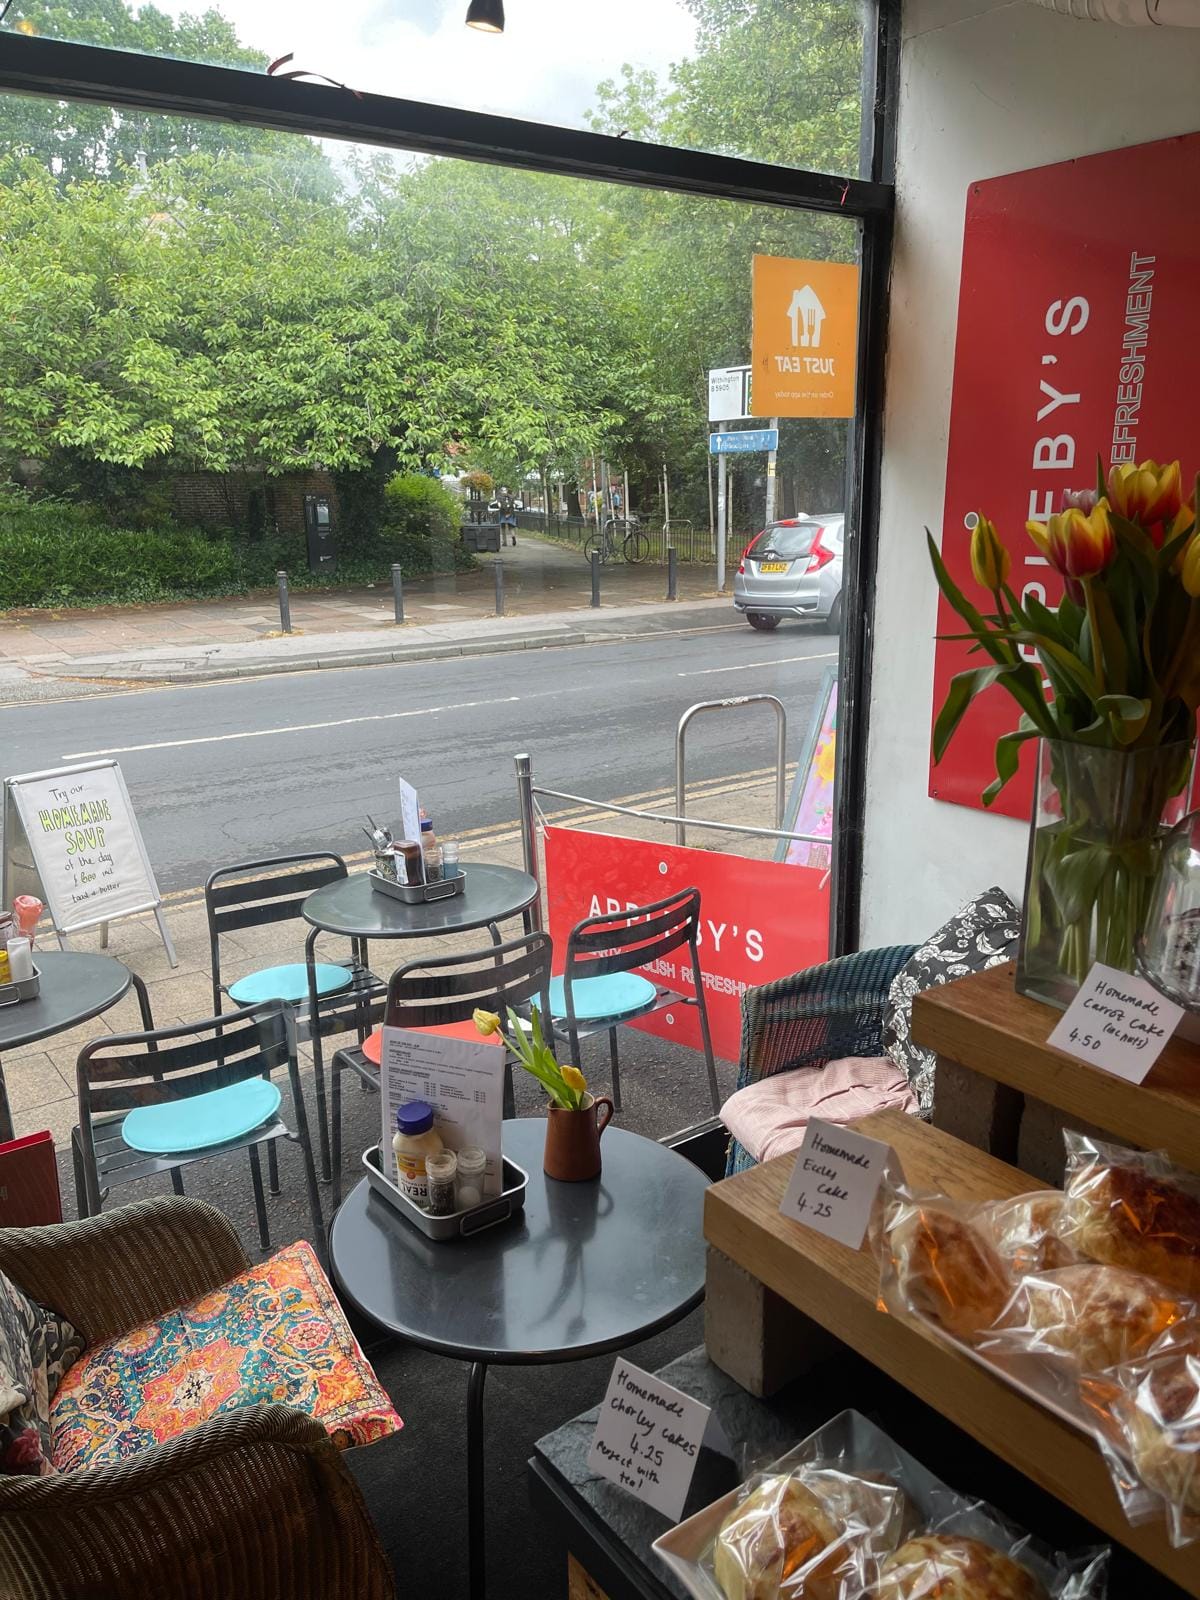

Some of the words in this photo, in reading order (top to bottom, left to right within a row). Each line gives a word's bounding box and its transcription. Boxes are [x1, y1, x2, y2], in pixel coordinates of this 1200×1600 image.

[1109, 251, 1156, 472] EFRESHMENT
[711, 375, 740, 384] Withington
[1020, 296, 1089, 690] PEBY'S
[48, 788, 69, 804] Try
[70, 784, 84, 795] our
[39, 799, 111, 832] HOMEMADE
[65, 827, 105, 855] SOUP
[65, 858, 74, 871] of
[78, 856, 95, 867] the
[98, 851, 114, 866] day
[589, 895, 764, 962] APPY'S
[638, 958, 676, 979] GLISH
[1095, 981, 1160, 1016] Homemade
[1083, 998, 1125, 1021] Carrot
[1129, 1018, 1165, 1038] Cake
[1069, 1028, 1101, 1050] 4.50
[1119, 1033, 1149, 1050] nuts)
[811, 1133, 870, 1169] Homemade
[797, 1192, 832, 1218] 4.25
[617, 1370, 685, 1418] Homemade
[610, 1397, 656, 1437] Chorley
[630, 1433, 665, 1467] 4.25
[619, 1471, 643, 1491] tea!
[637, 1464, 660, 1484] with
